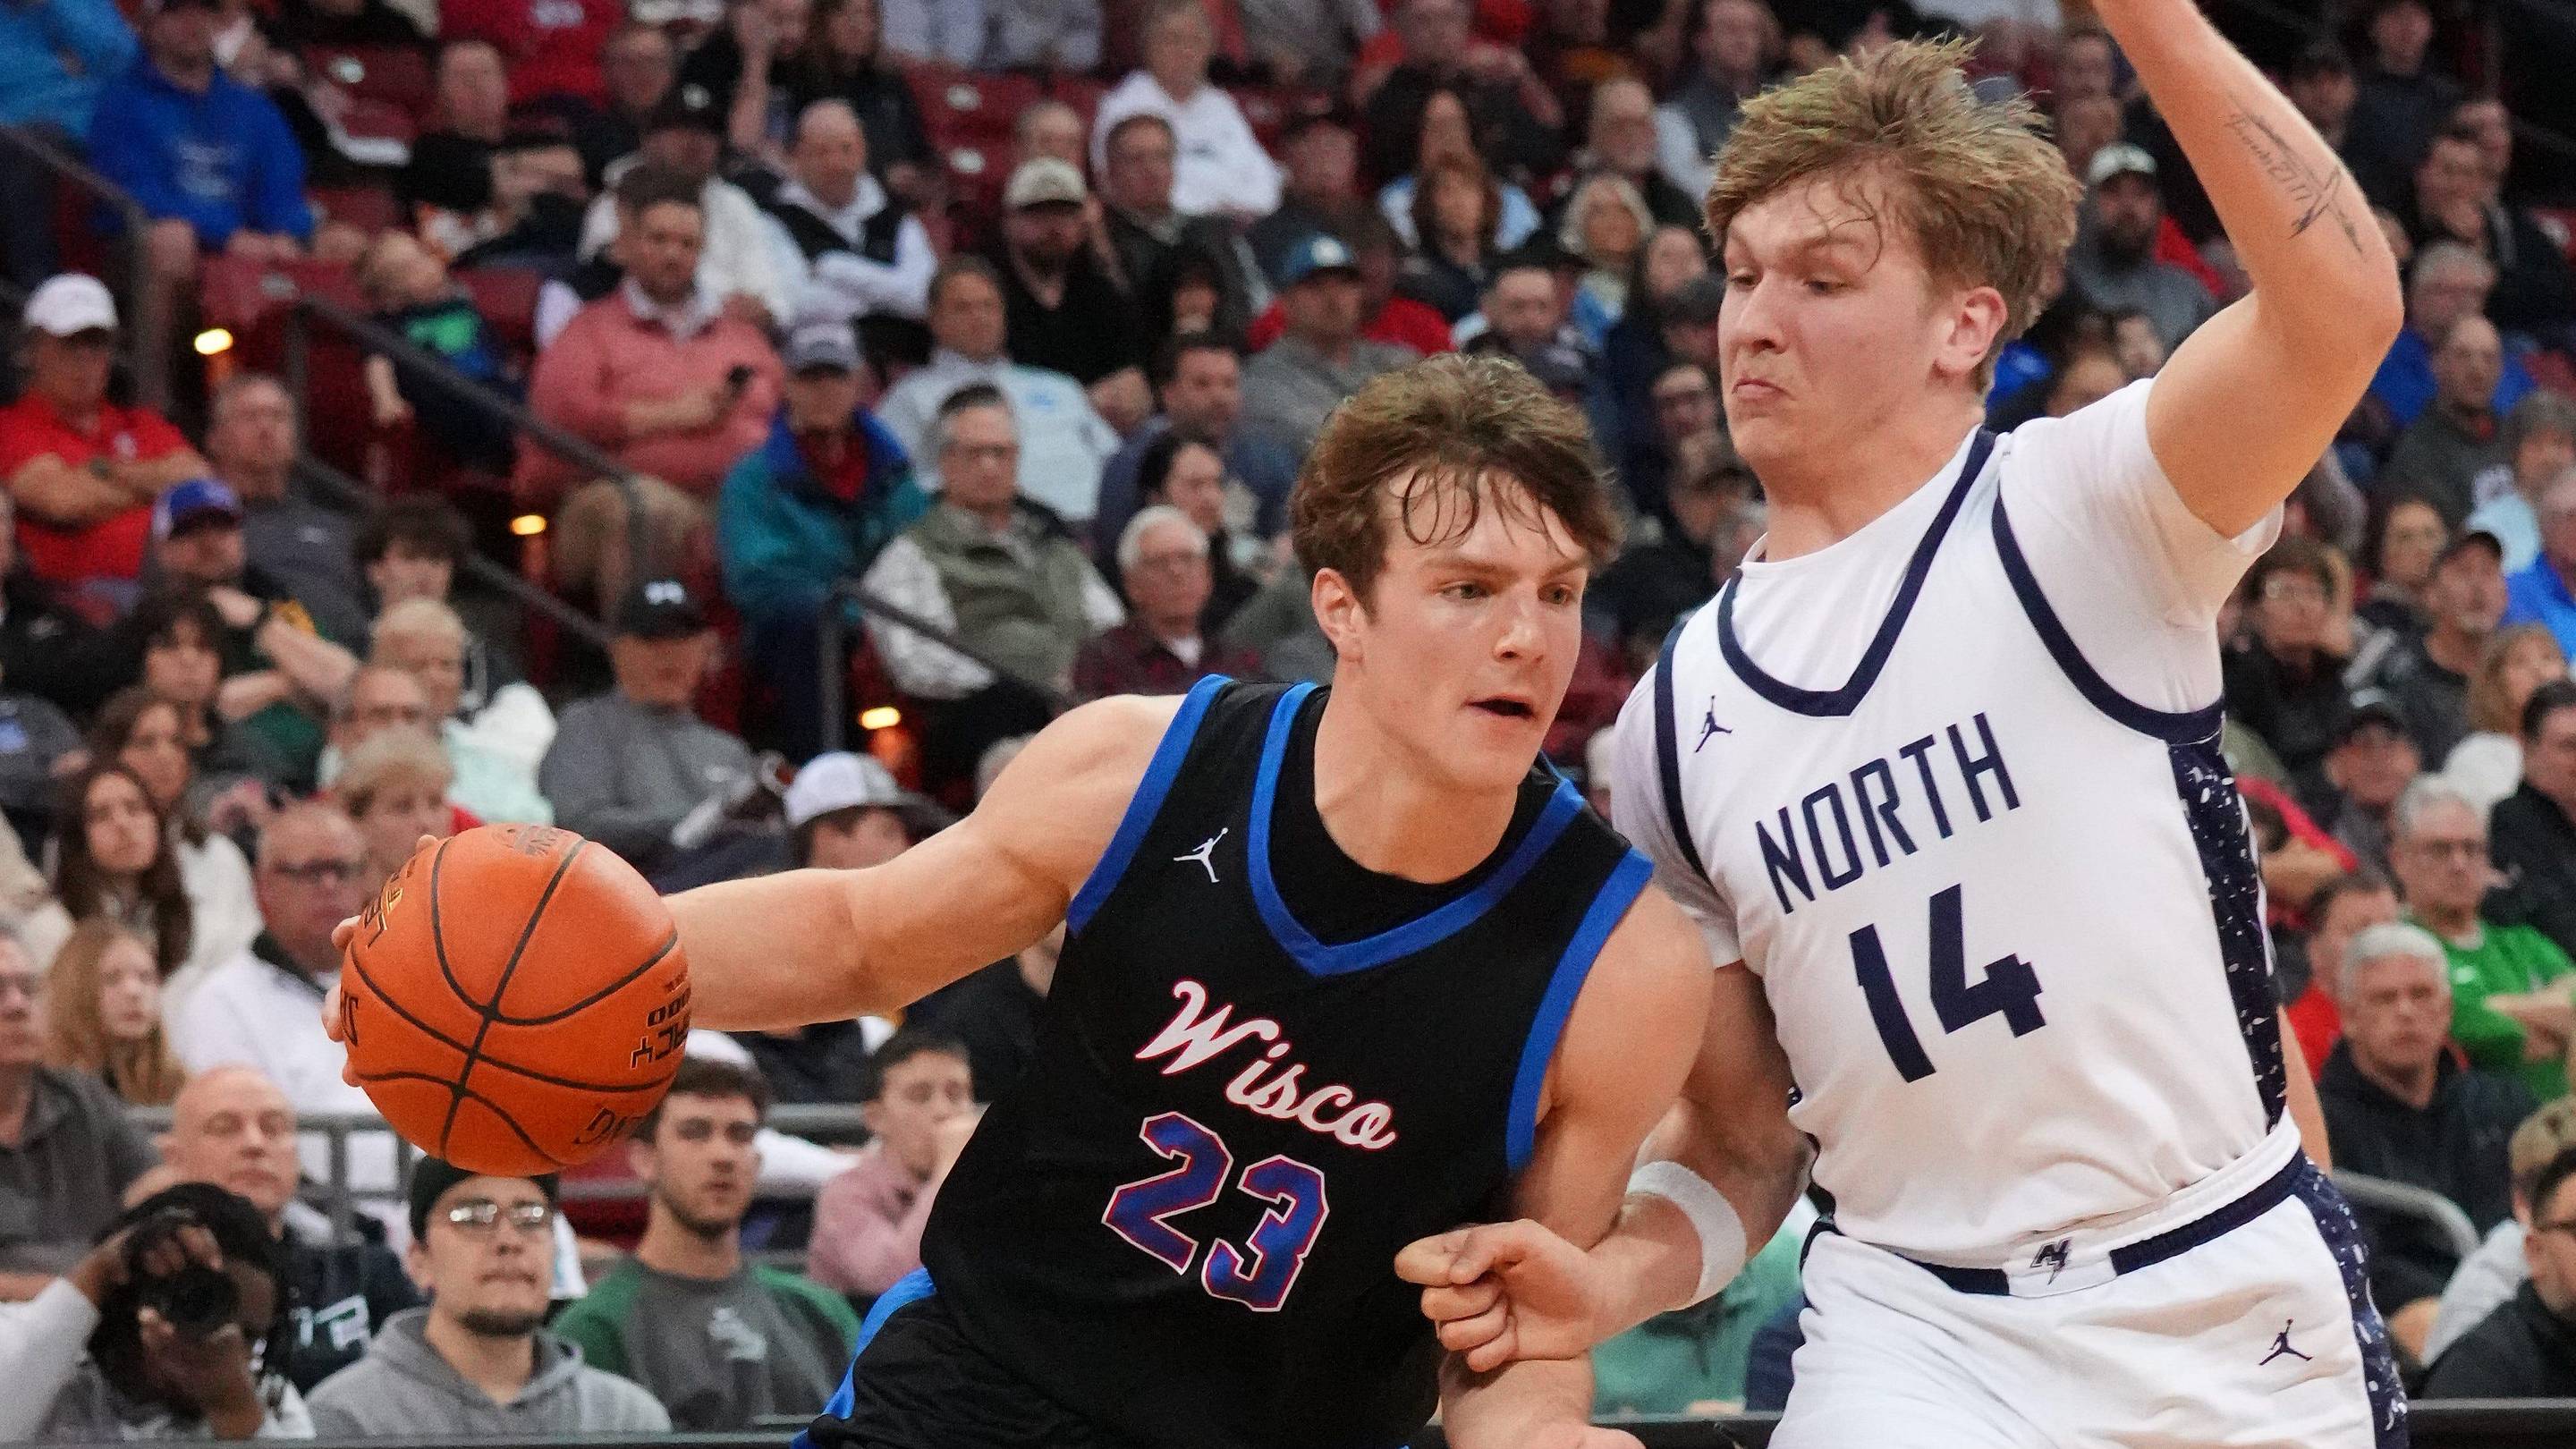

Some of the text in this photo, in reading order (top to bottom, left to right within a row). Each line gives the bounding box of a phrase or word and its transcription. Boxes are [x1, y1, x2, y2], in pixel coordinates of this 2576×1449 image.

[1755, 712, 2021, 914] NORTH
[1134, 977, 1399, 1151] Wisco
[1849, 884, 2046, 1083] 14
[1101, 1110, 1330, 1313] 23
